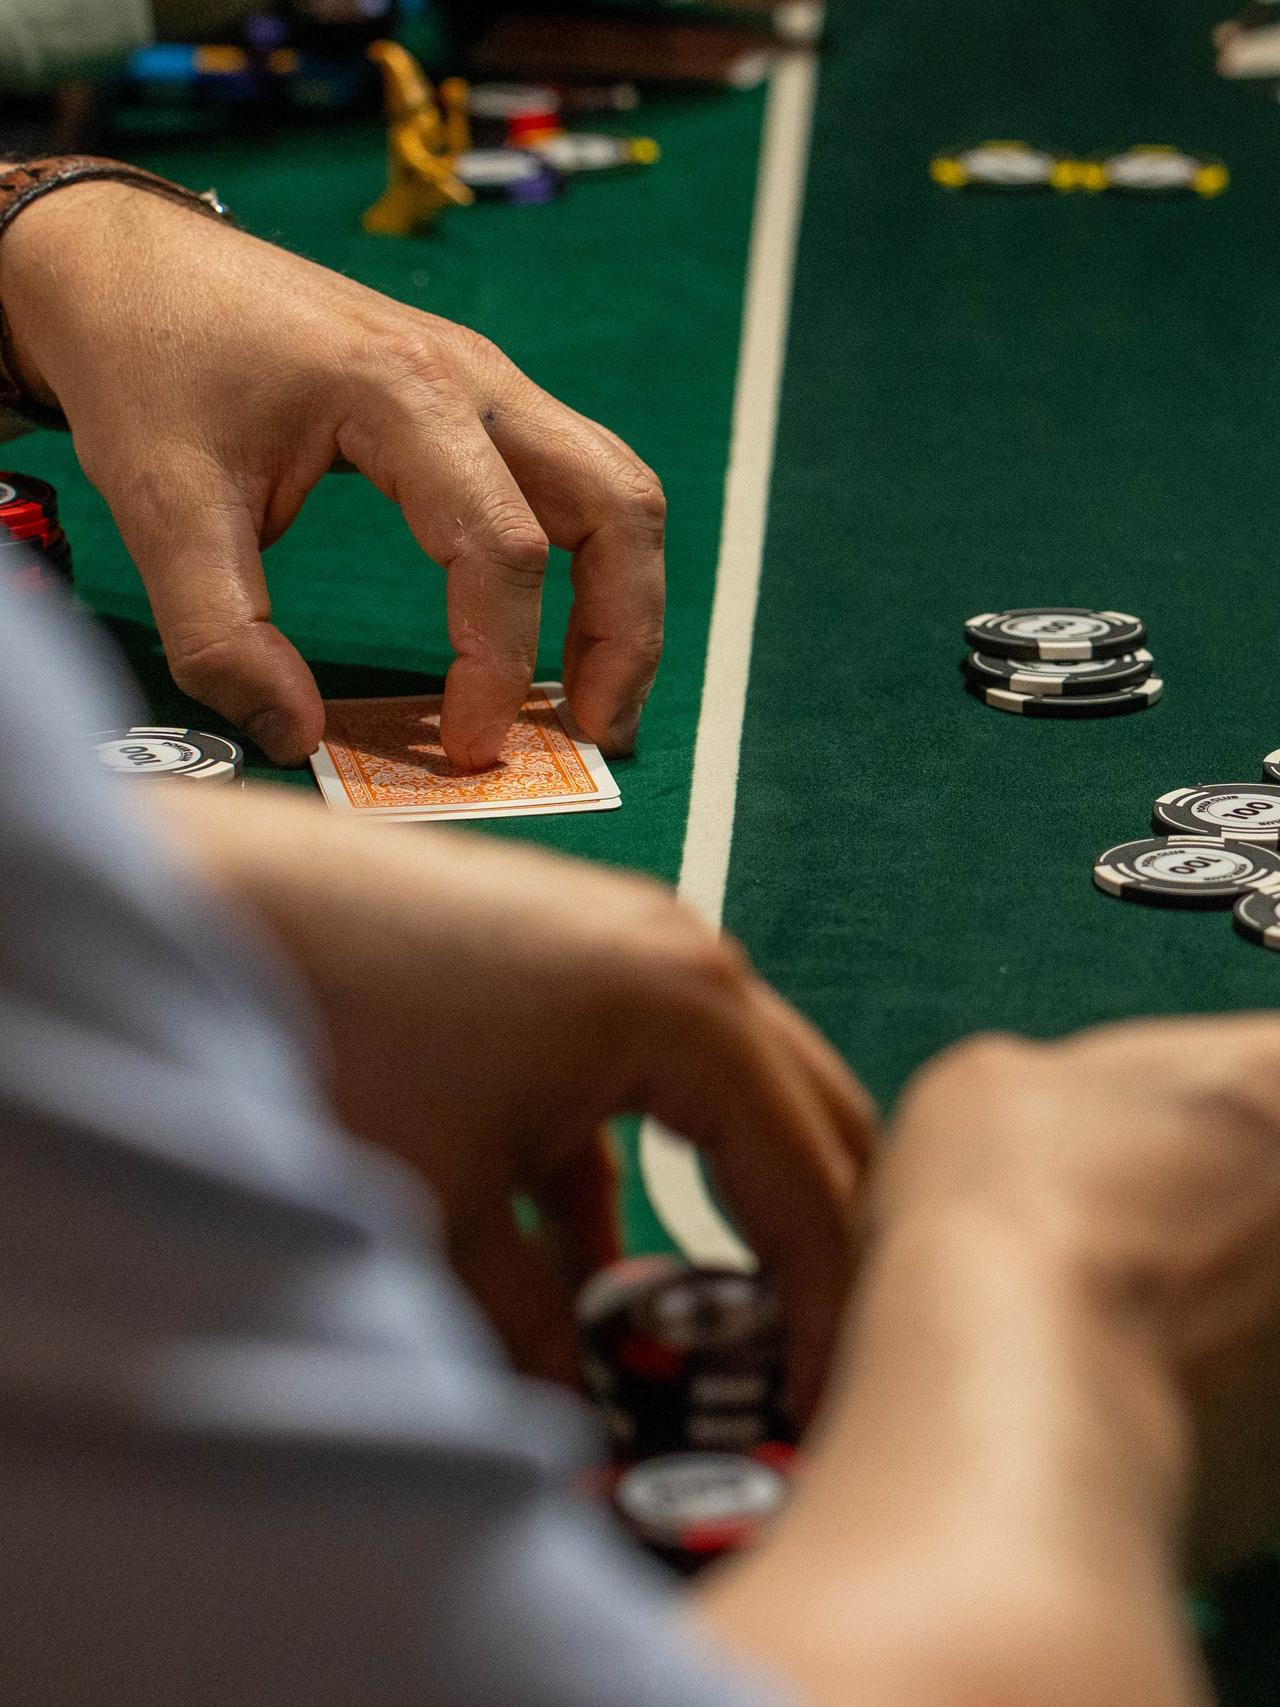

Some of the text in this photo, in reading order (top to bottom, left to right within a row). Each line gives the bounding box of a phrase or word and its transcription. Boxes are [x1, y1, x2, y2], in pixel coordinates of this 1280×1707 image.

[120, 746, 162, 765] 100
[1197, 801, 1211, 813] POKER
[1221, 801, 1273, 820] 100
[1168, 856, 1222, 874] 100
